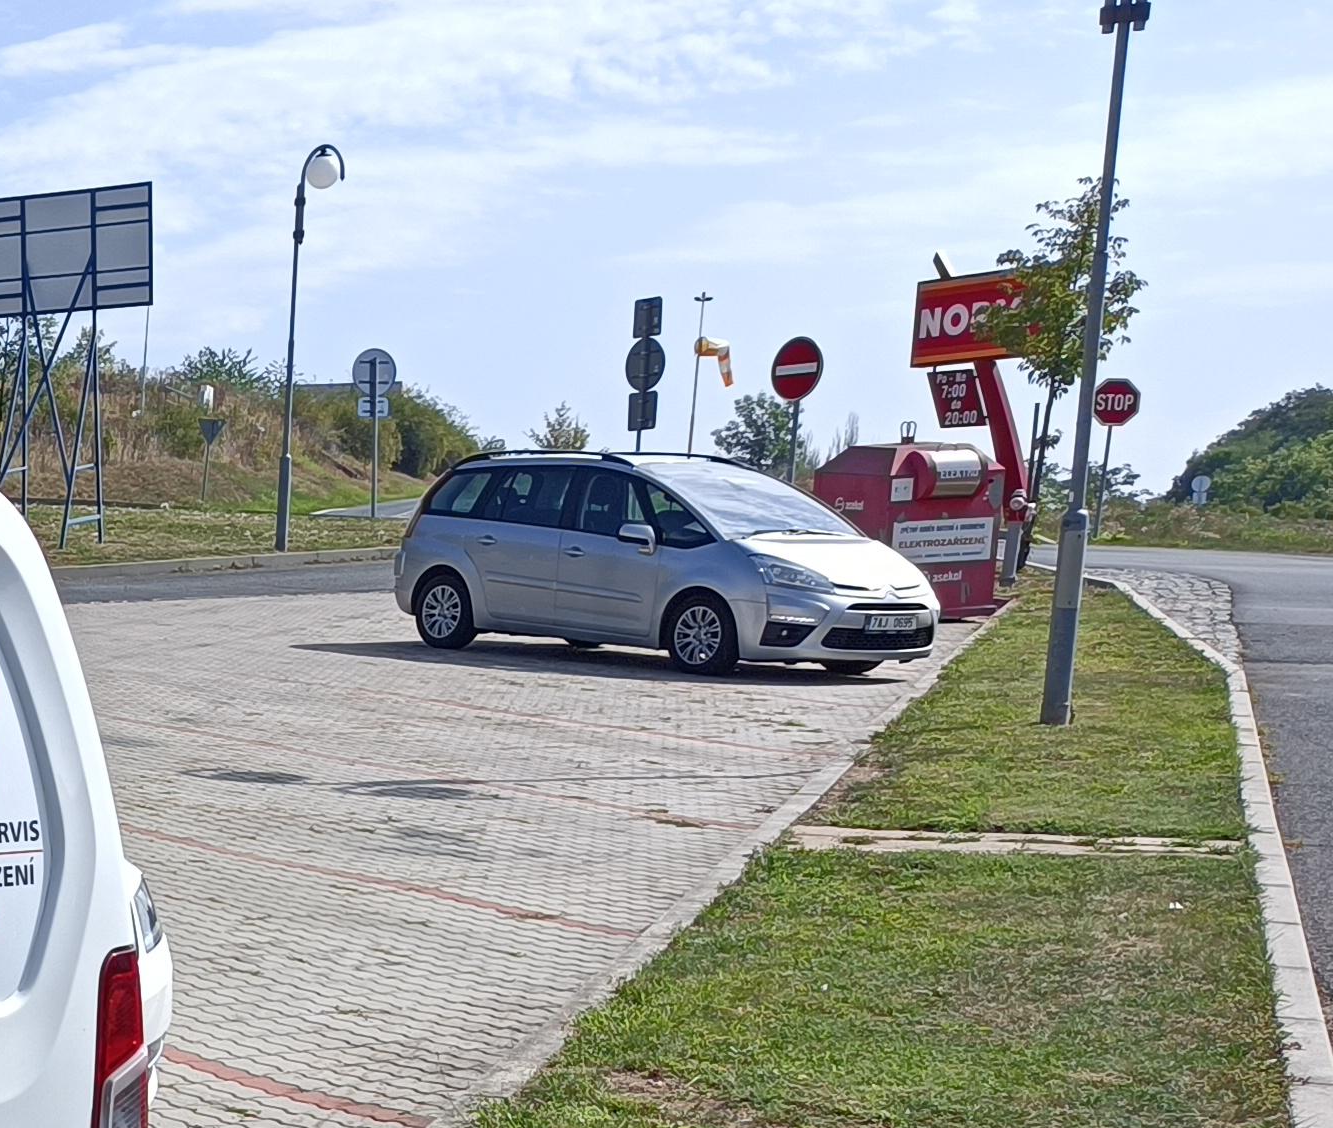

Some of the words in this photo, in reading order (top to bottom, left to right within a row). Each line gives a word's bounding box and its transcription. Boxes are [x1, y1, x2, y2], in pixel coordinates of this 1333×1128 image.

[941, 384, 967, 398] 7:00
[1096, 393, 1135, 411] STOP
[944, 410, 978, 425] 20:00
